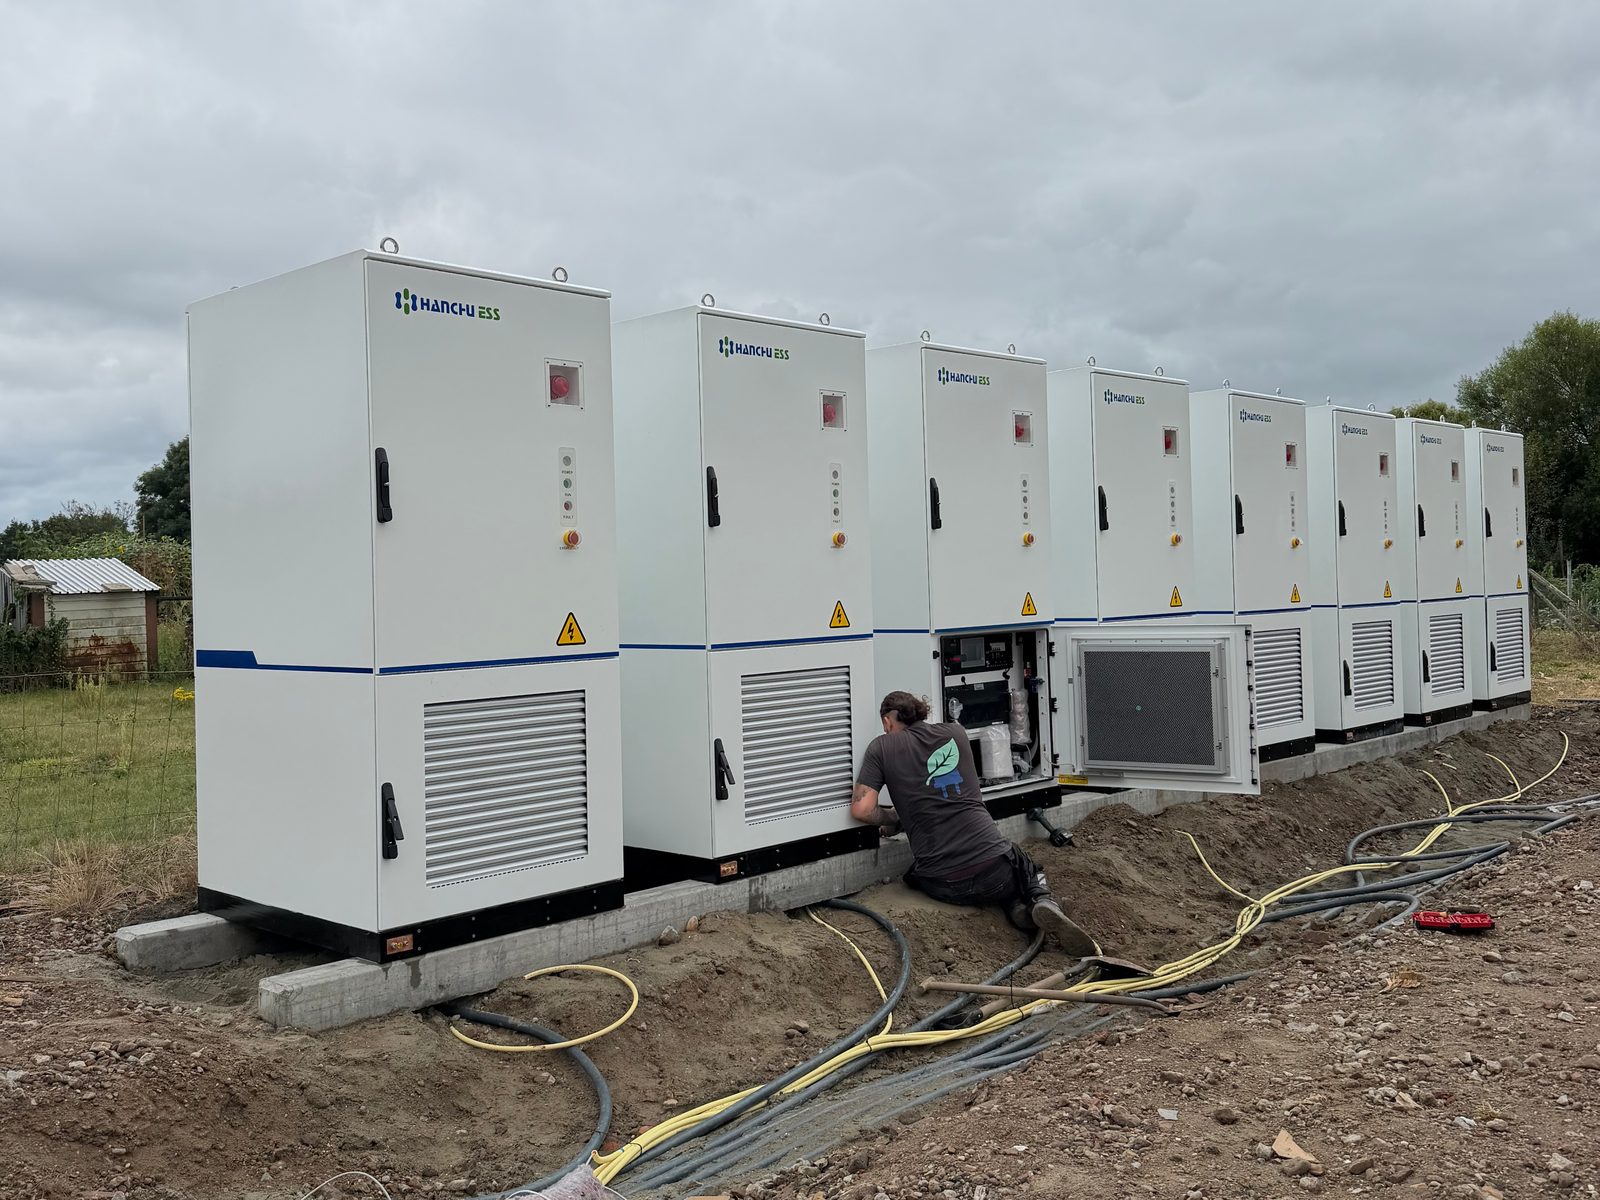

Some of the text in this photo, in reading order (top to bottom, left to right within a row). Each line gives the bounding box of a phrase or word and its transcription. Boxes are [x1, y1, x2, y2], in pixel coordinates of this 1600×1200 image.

[420, 297, 501, 321] HANCHU ESS
[735, 343, 790, 360] HANCHU ESS
[950, 372, 990, 386] HANCHU ESS
